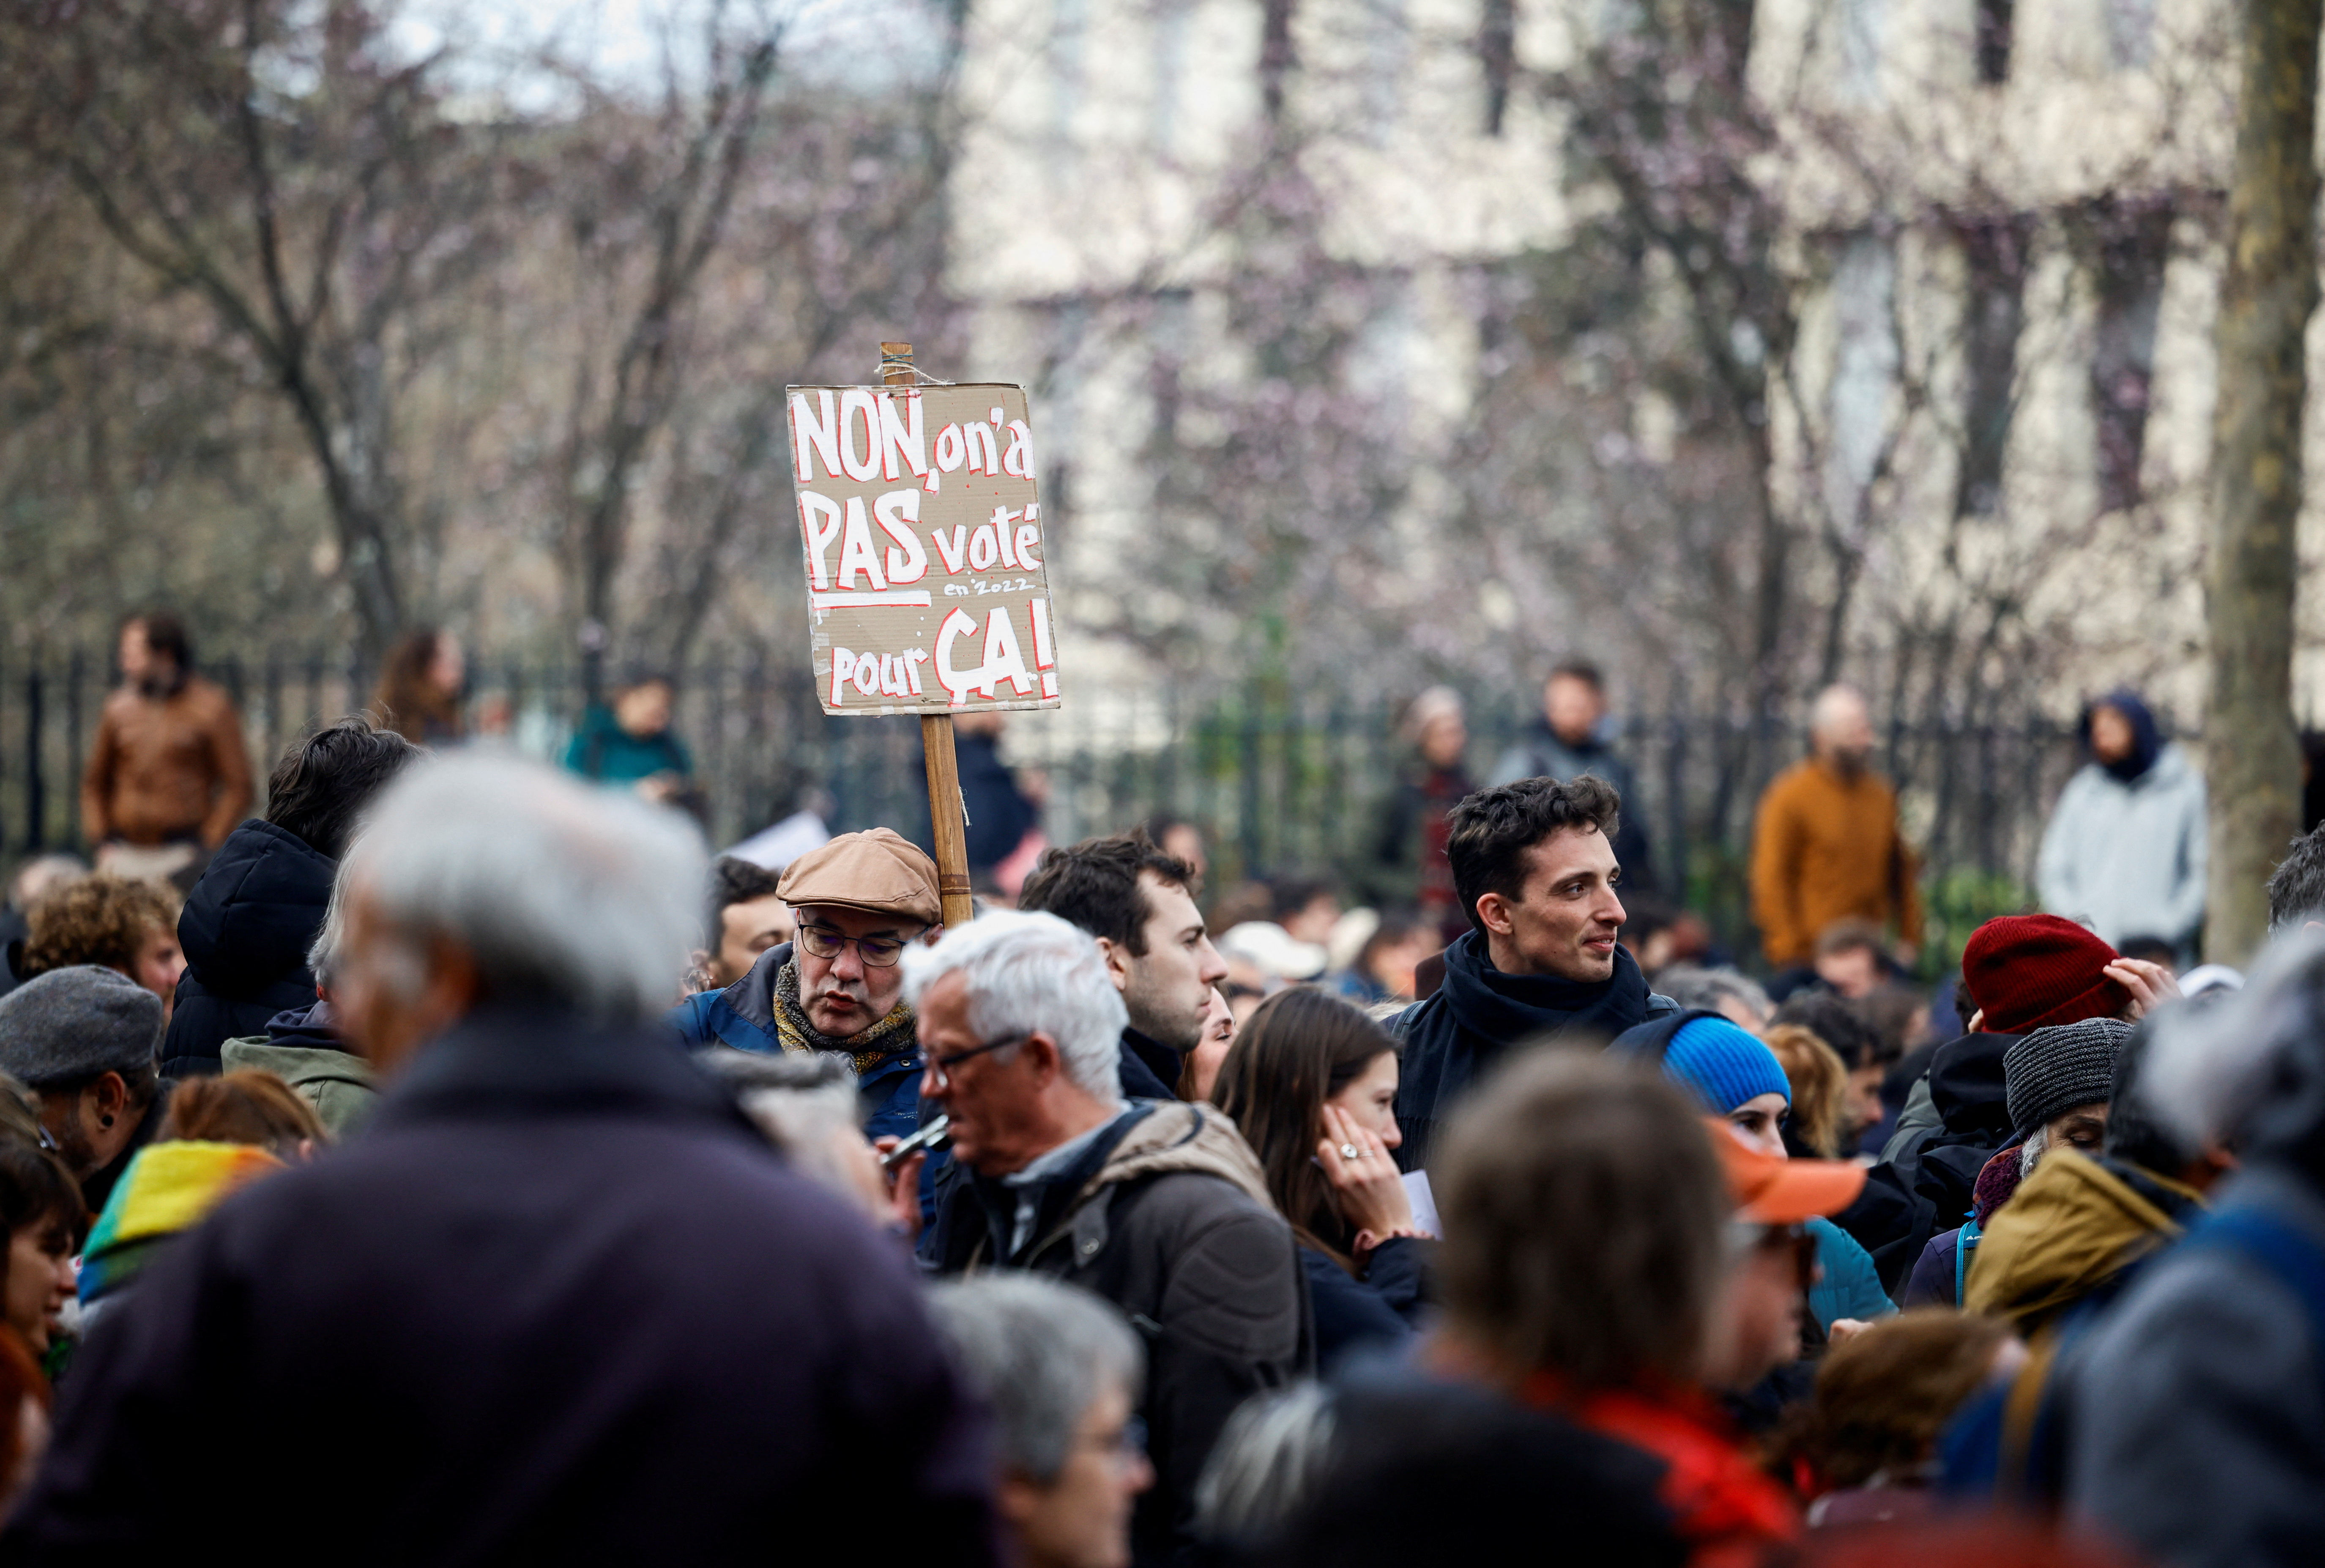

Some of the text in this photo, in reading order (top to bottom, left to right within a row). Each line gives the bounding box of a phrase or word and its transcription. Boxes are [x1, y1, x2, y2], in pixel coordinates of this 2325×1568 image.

[791, 389, 1036, 496] NON, on'a
[798, 489, 1042, 591] PAS voté
[944, 577, 1037, 597] en 2022
[830, 598, 1058, 707] pour ÇA!
